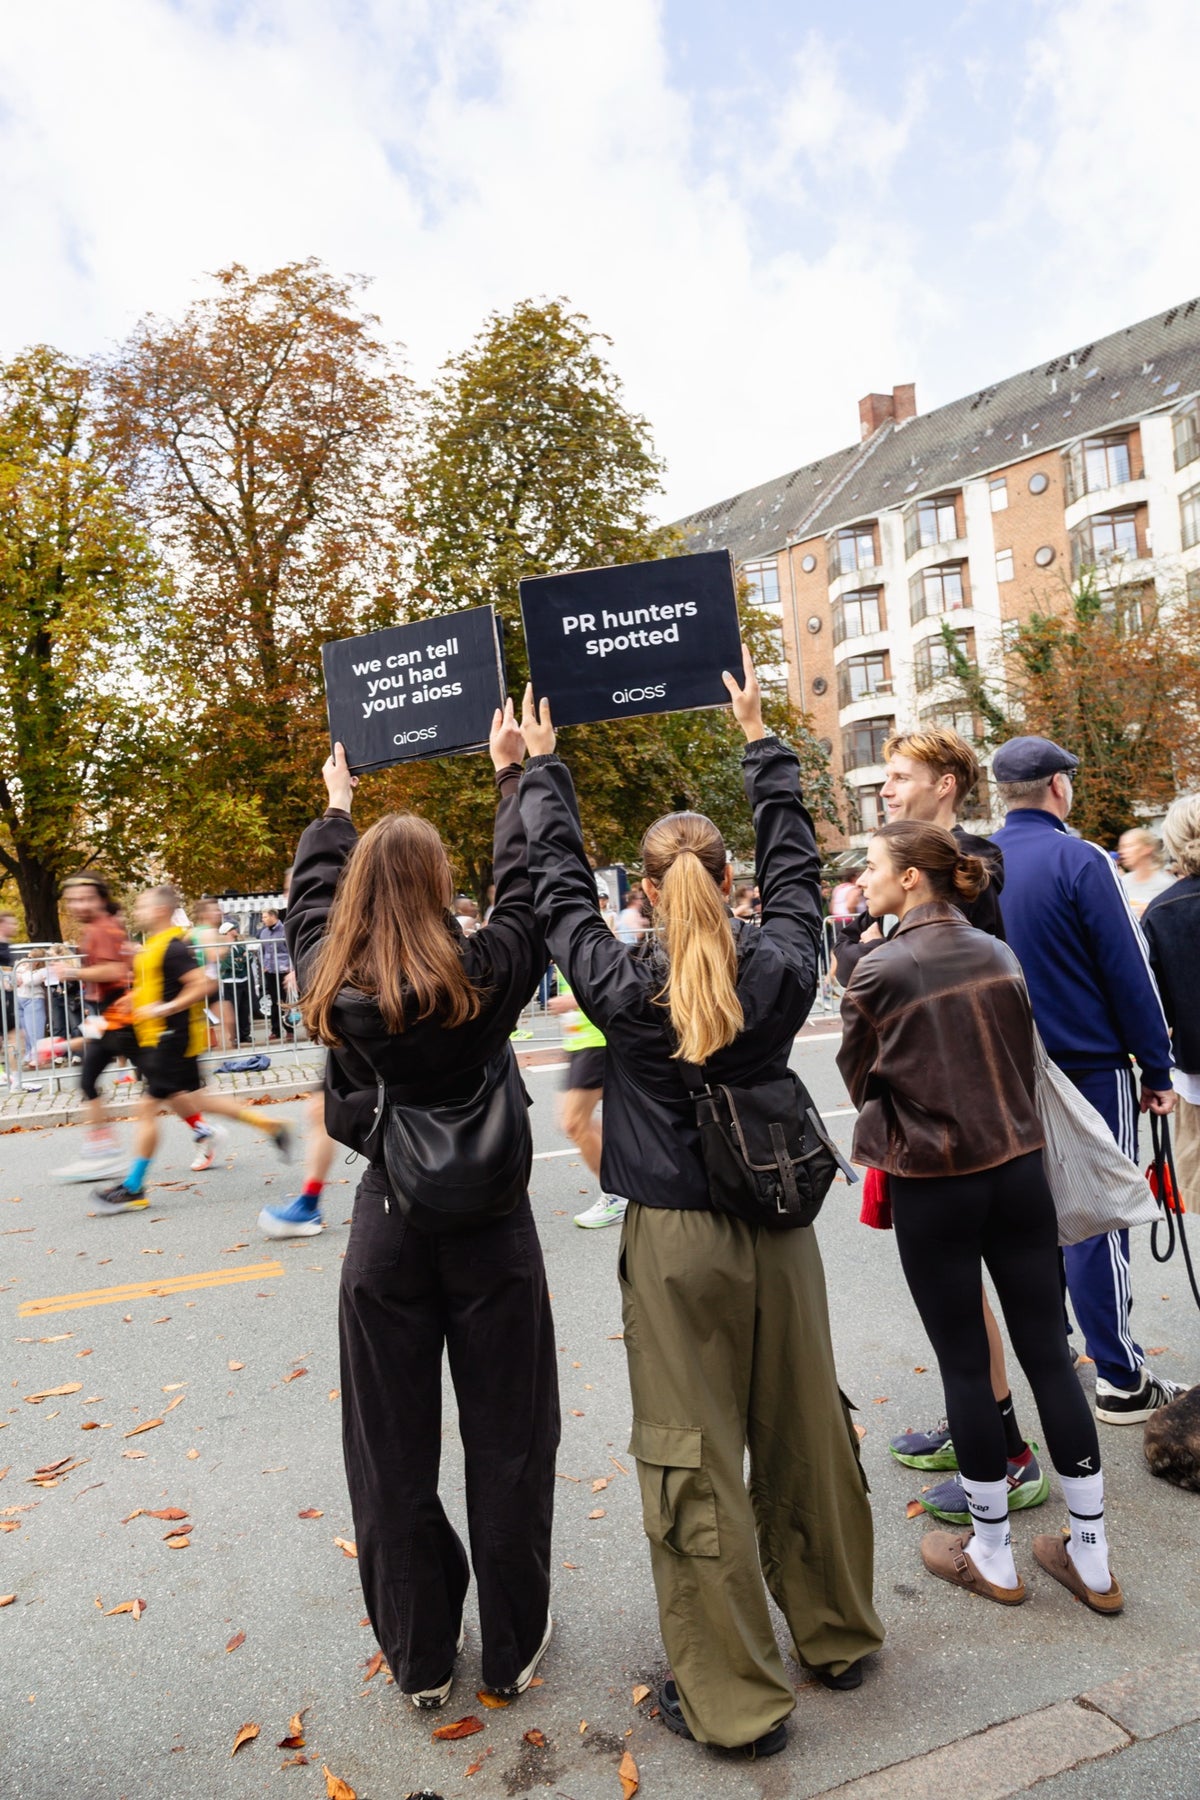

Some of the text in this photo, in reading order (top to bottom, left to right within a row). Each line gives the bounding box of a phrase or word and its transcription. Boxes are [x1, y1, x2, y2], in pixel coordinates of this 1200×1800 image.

[562, 601, 698, 635] PR hunters
[352, 637, 459, 676] we can tell
[585, 622, 680, 657] spotted
[367, 661, 447, 697] you had
[361, 681, 463, 719] your aioss
